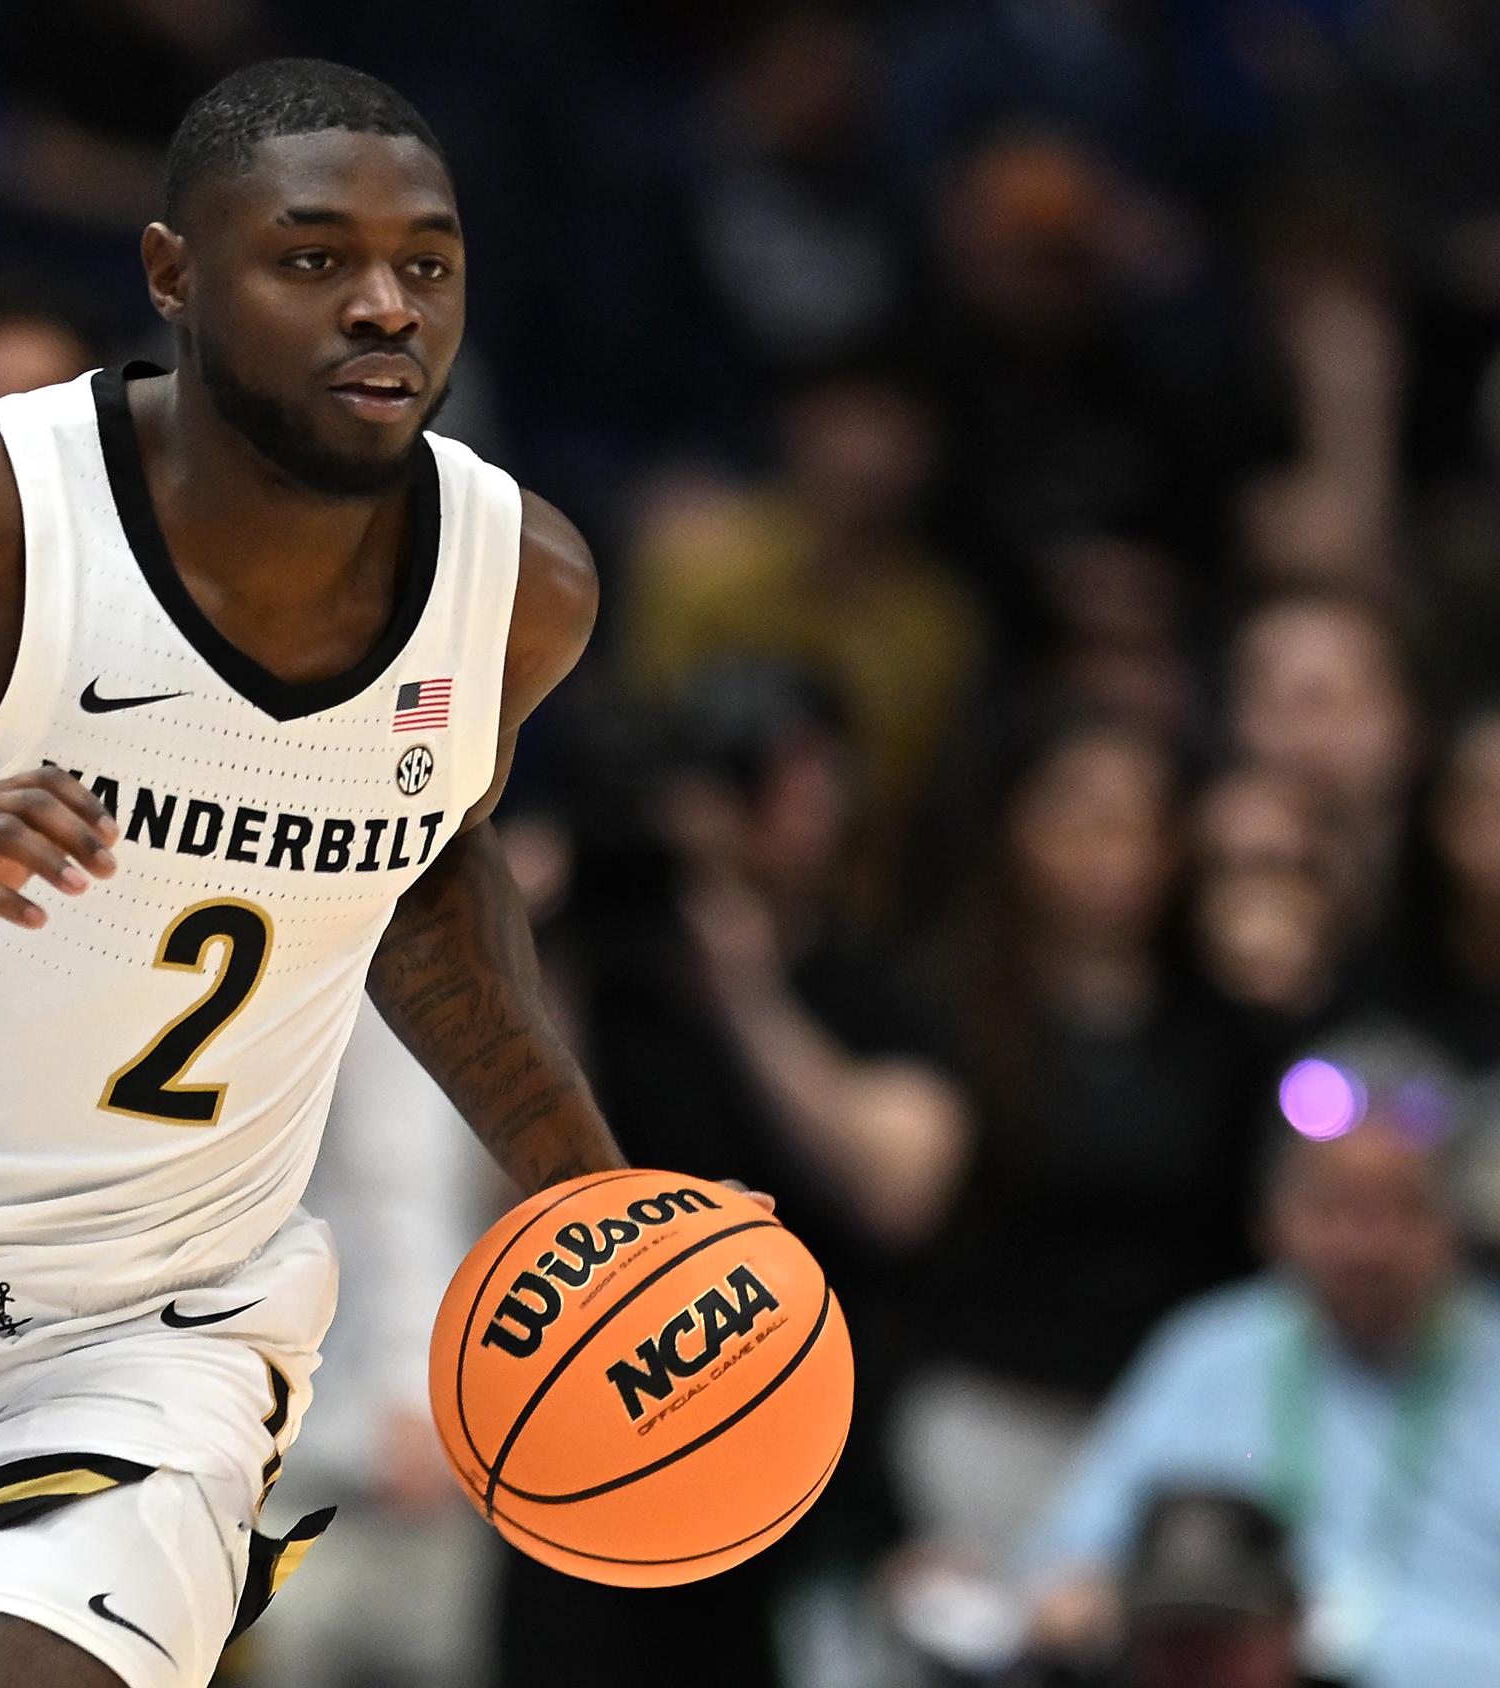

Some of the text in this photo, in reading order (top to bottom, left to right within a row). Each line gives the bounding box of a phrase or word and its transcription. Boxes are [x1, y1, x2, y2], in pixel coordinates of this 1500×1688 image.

[41, 759, 444, 873] ANDERBILT
[397, 745, 433, 795] SEC
[97, 896, 274, 1127] 2
[481, 1187, 723, 1359] Wilson
[605, 1264, 780, 1422] NCAA
[637, 1316, 789, 1437] OFFICIAL GAME BALL
